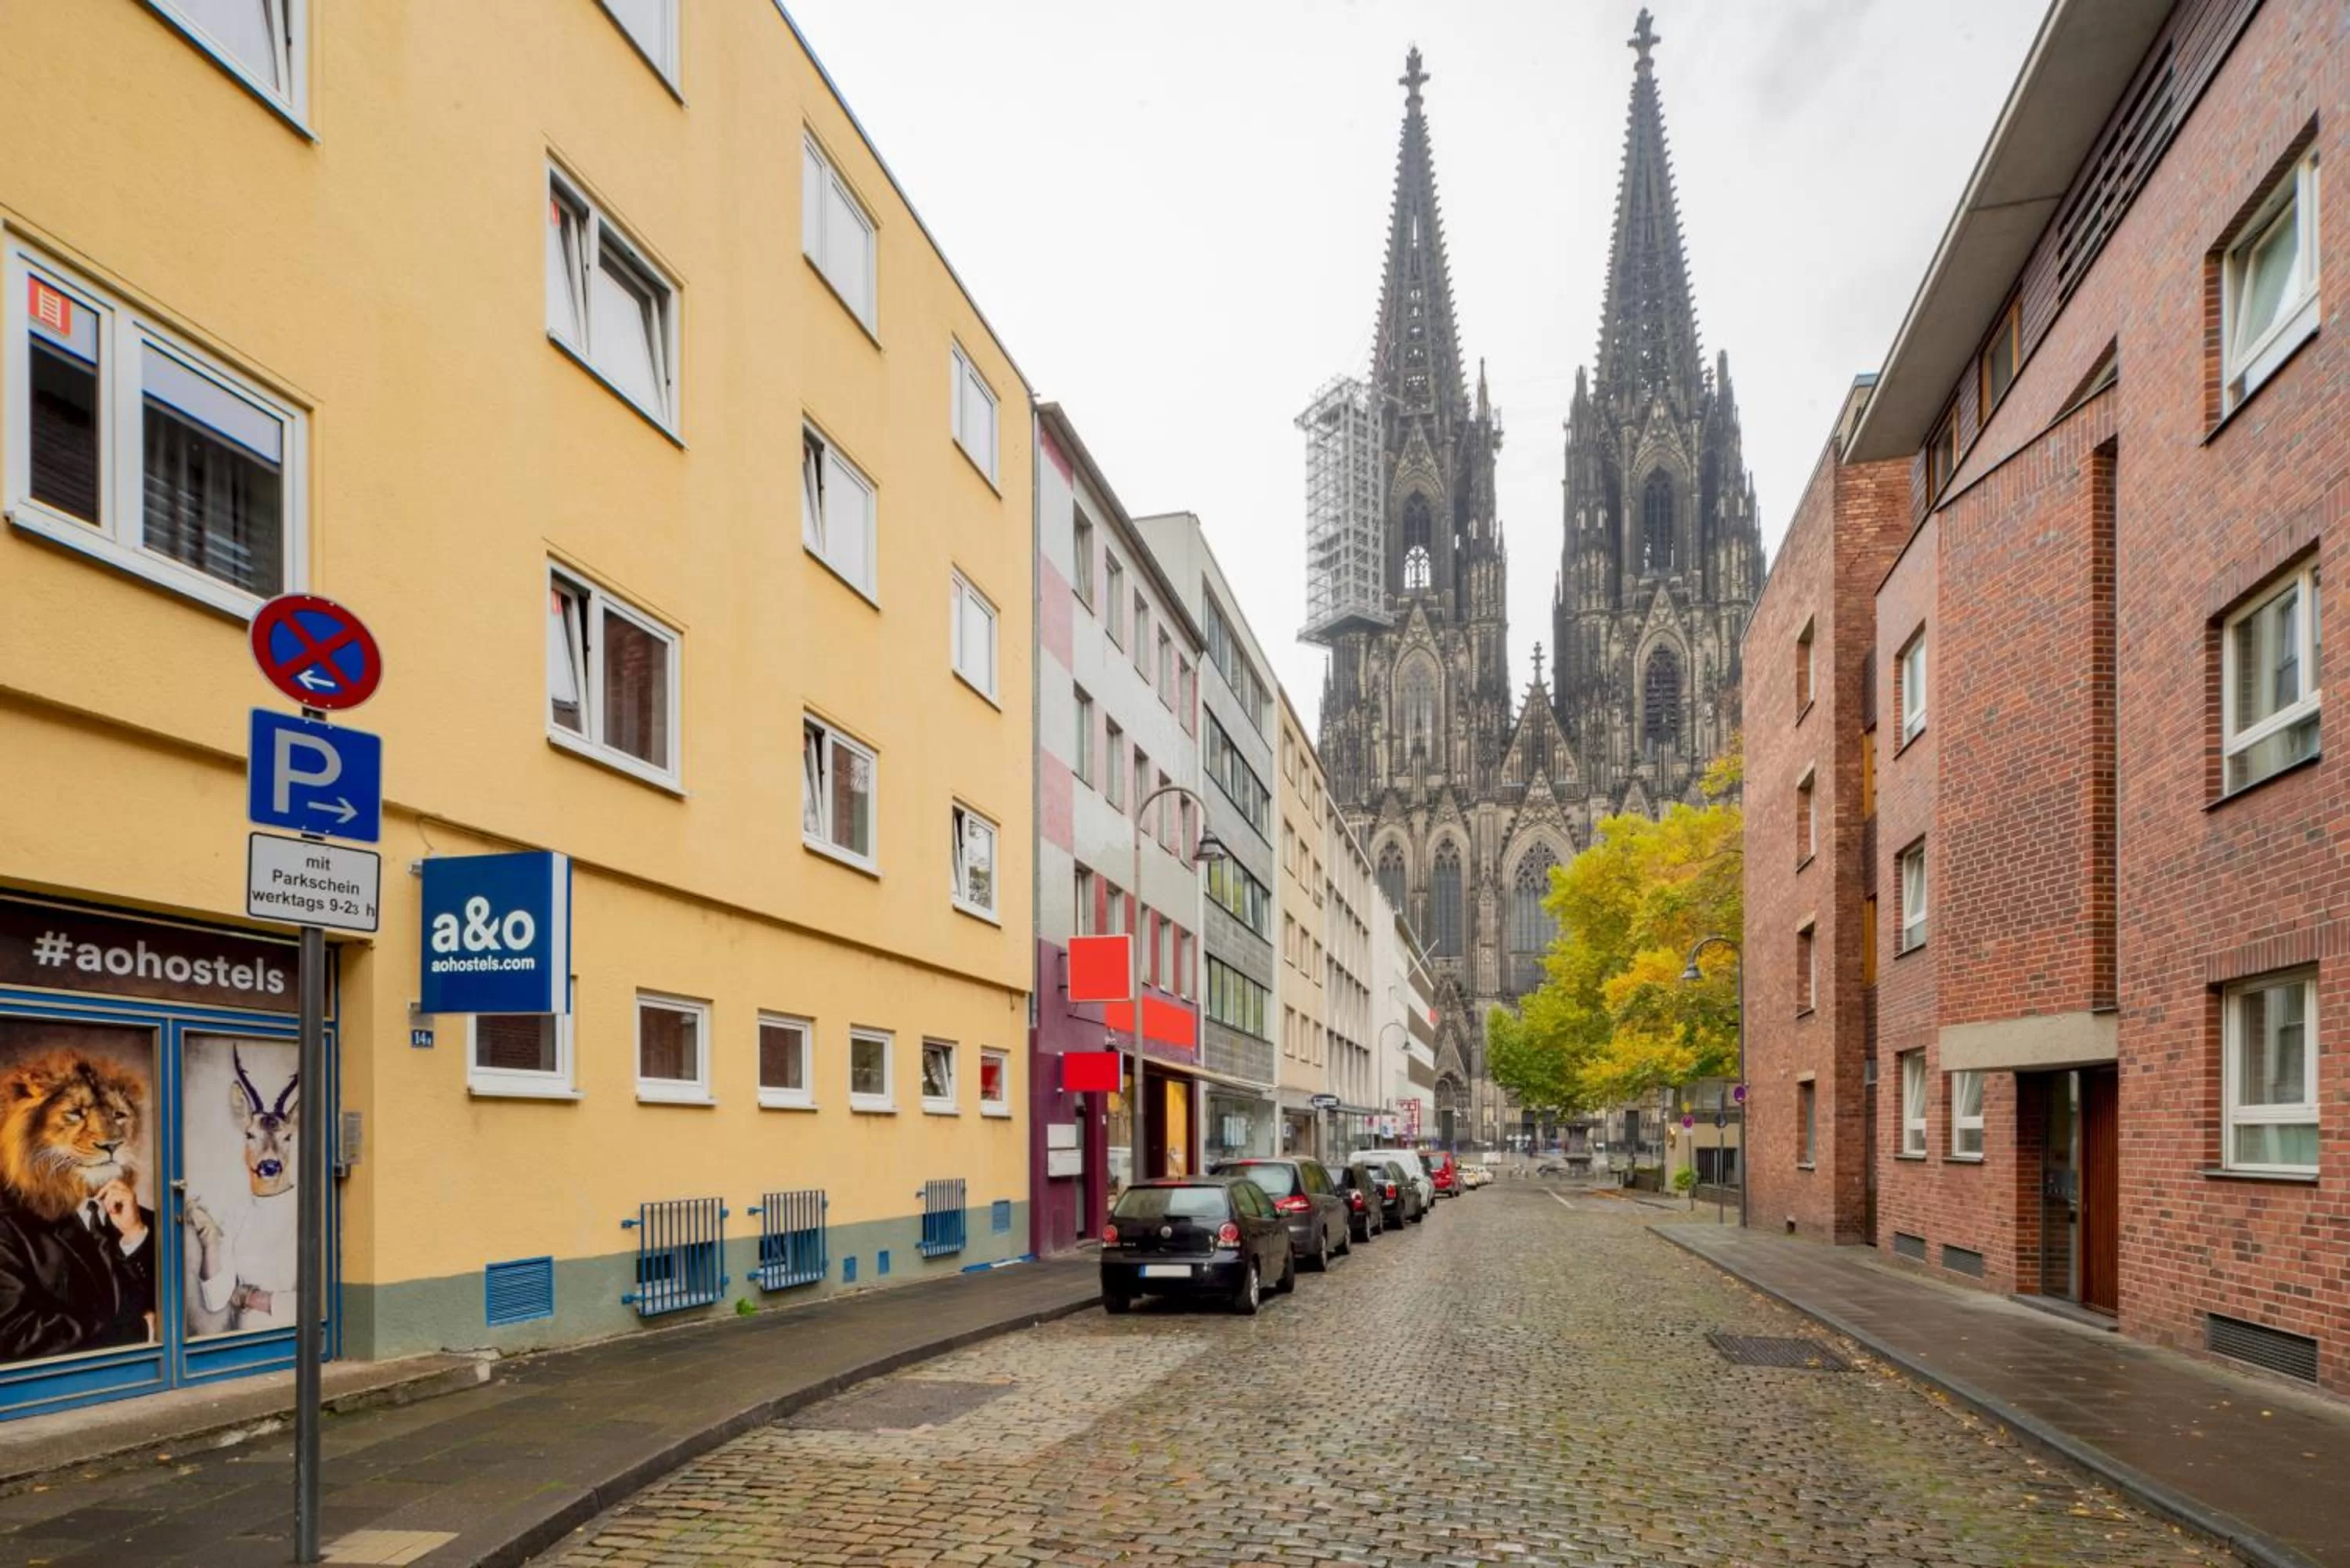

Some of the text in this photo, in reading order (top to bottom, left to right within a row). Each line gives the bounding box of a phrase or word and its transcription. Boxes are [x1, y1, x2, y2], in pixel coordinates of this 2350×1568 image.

[273, 727, 342, 815] P
[306, 857, 331, 871] mit
[272, 869, 360, 895] Parkschein
[251, 889, 376, 917] werktags 9-23 h
[432, 896, 536, 953] a&o
[32, 930, 285, 995] #aohostels
[431, 955, 536, 973] aohostels.com
